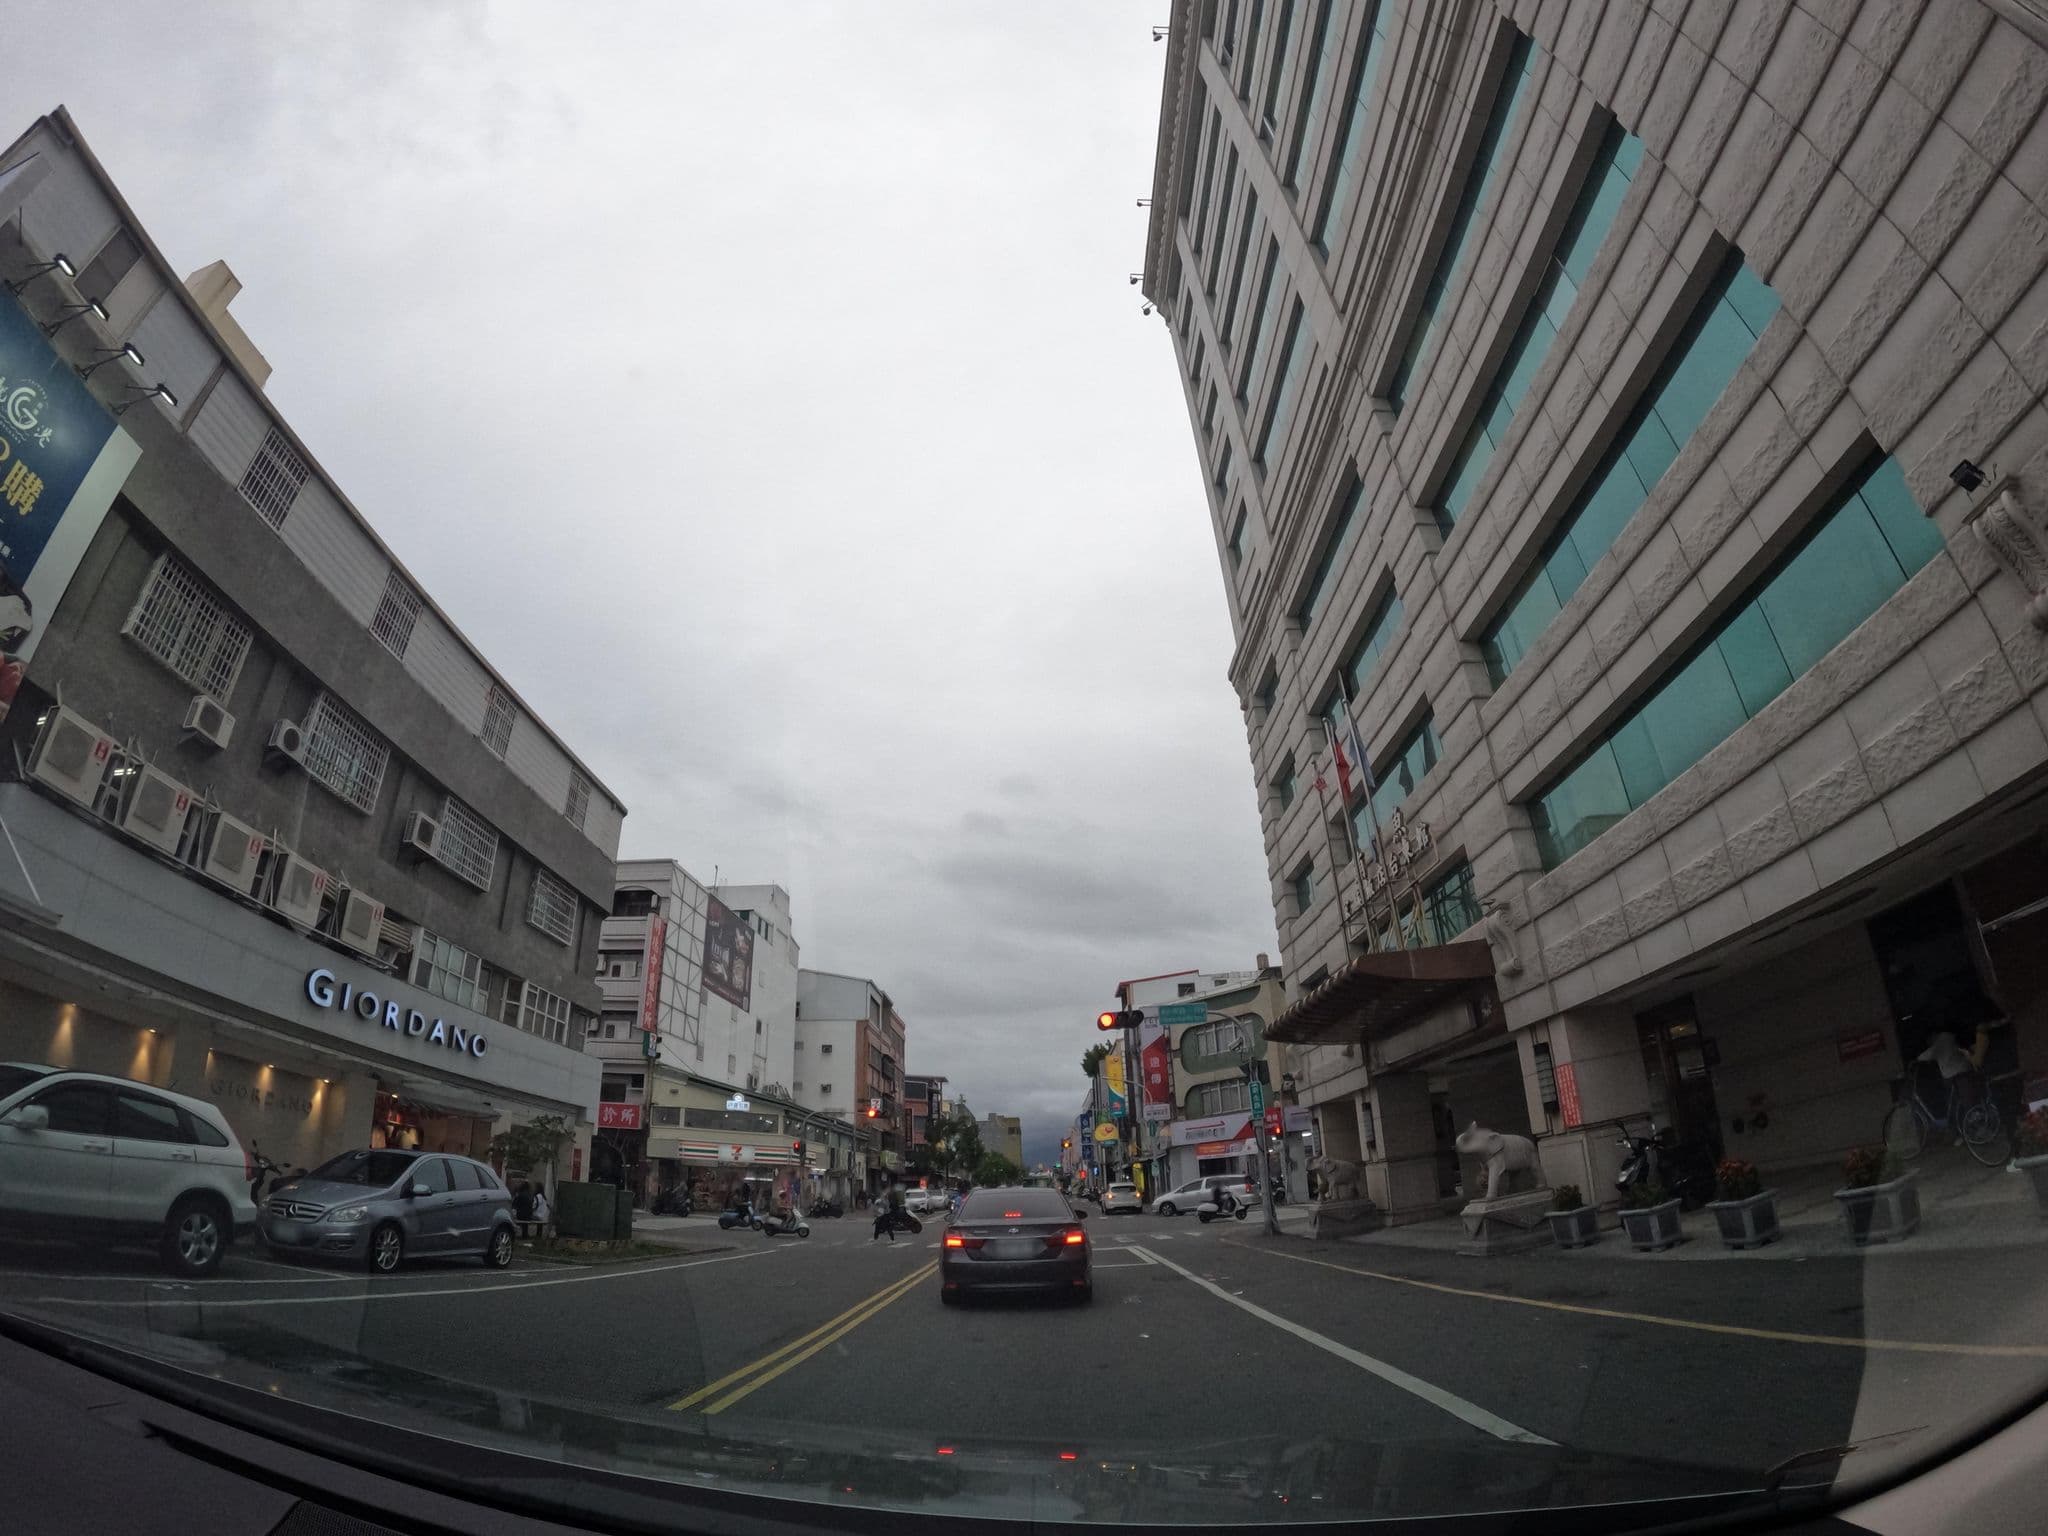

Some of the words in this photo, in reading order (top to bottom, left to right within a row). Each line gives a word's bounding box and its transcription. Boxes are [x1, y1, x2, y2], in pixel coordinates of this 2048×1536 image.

[306, 968, 488, 1058] GIORDANO
[212, 1080, 312, 1113] GIORDANO
[603, 1106, 635, 1126] 診所
